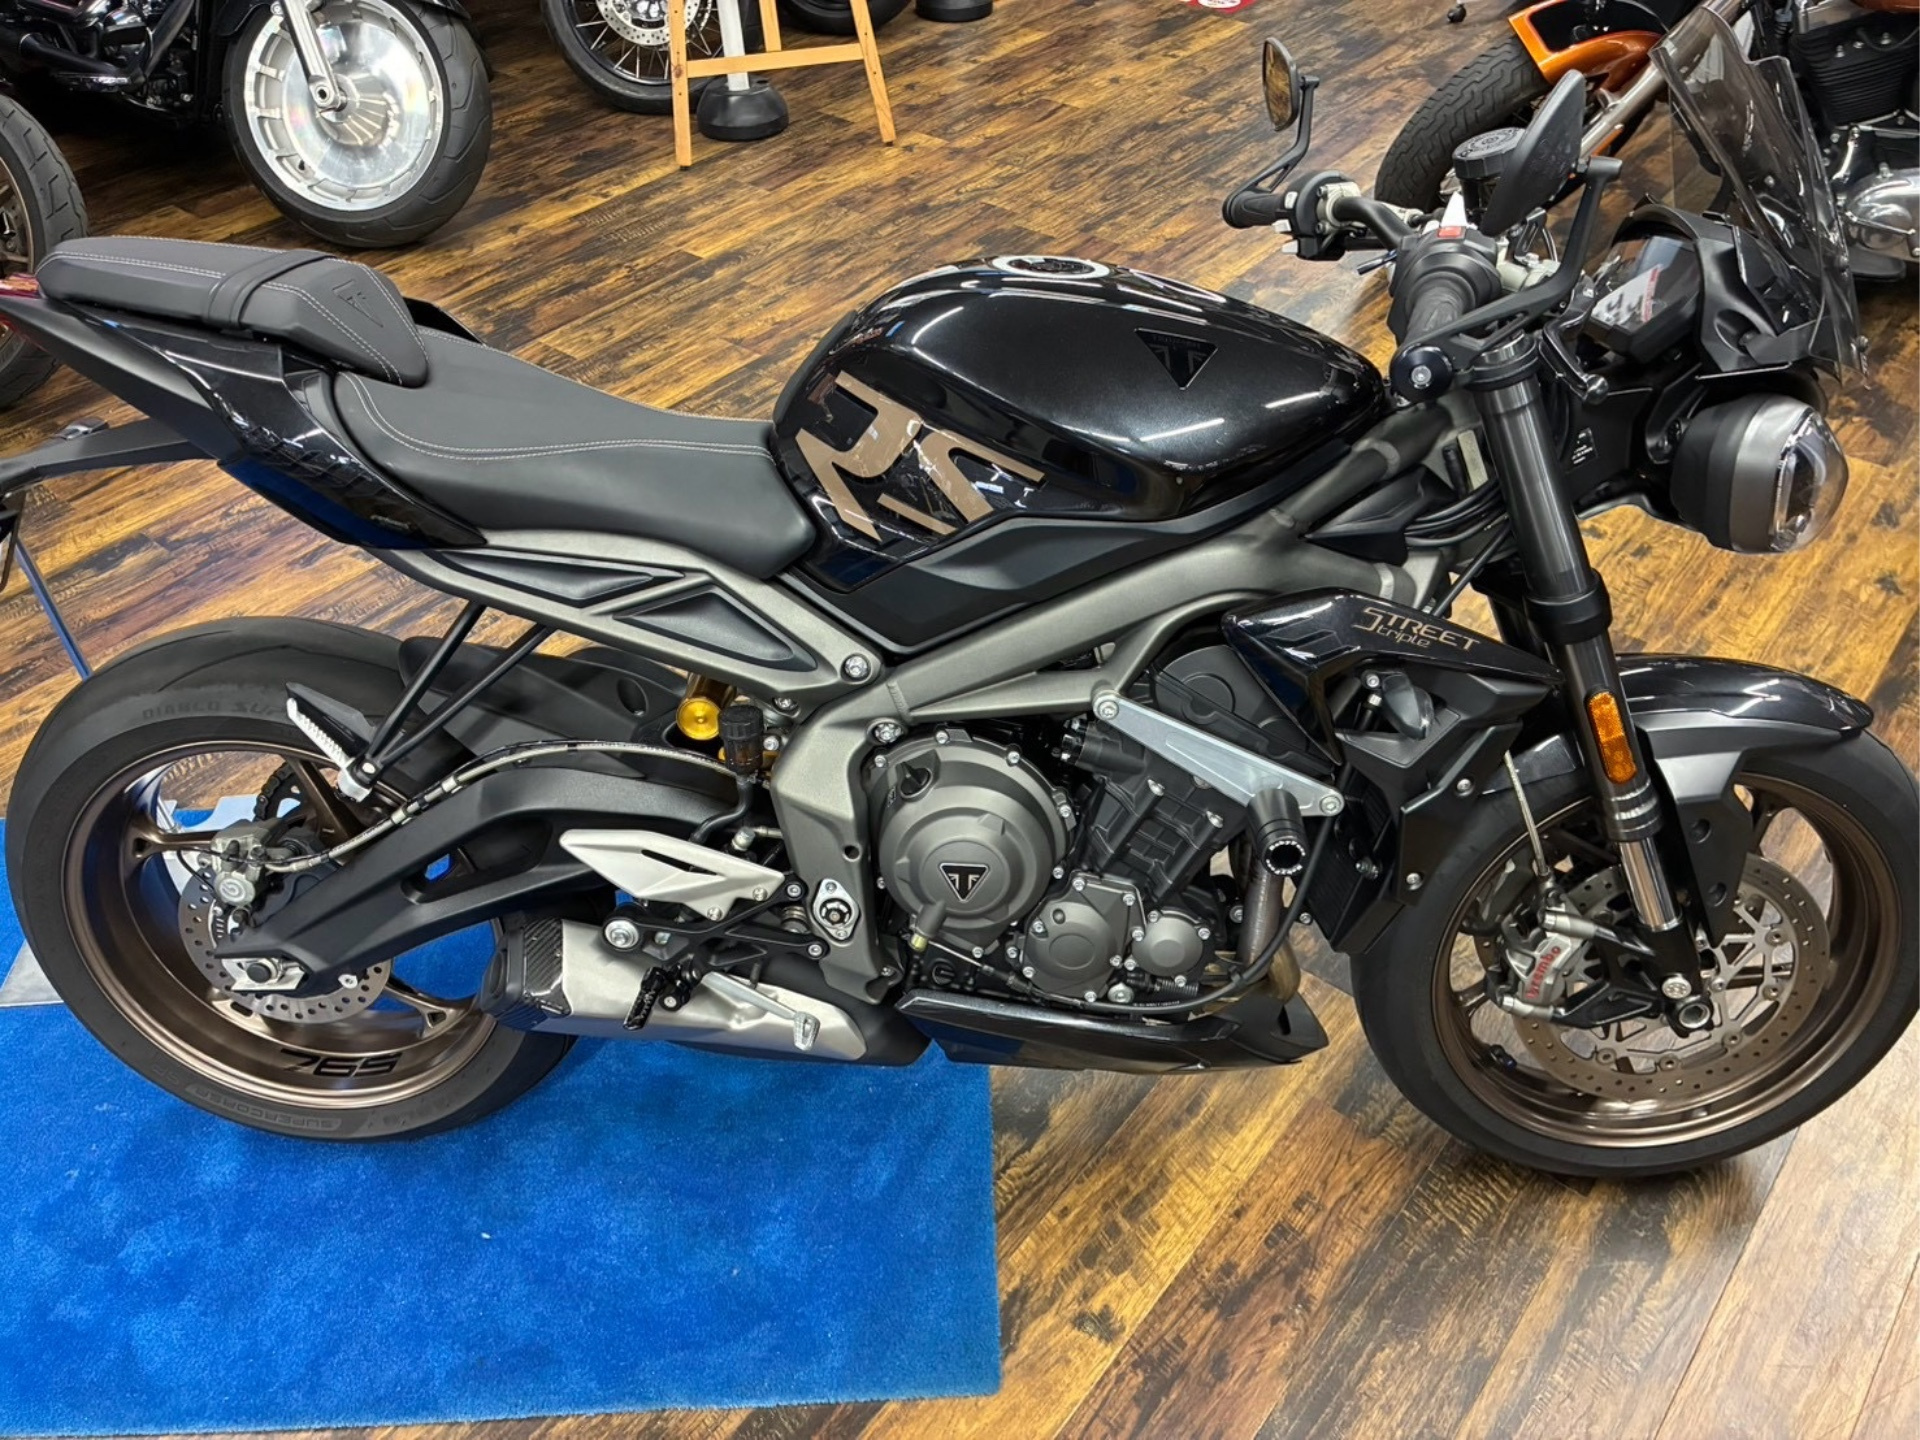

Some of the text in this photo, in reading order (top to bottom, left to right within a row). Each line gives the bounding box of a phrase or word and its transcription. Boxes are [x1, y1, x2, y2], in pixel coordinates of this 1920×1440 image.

[1351, 606, 1480, 651] STREET
[1376, 624, 1431, 649] triple
[1525, 945, 1561, 999] brembo
[280, 1048, 402, 1077] 765
